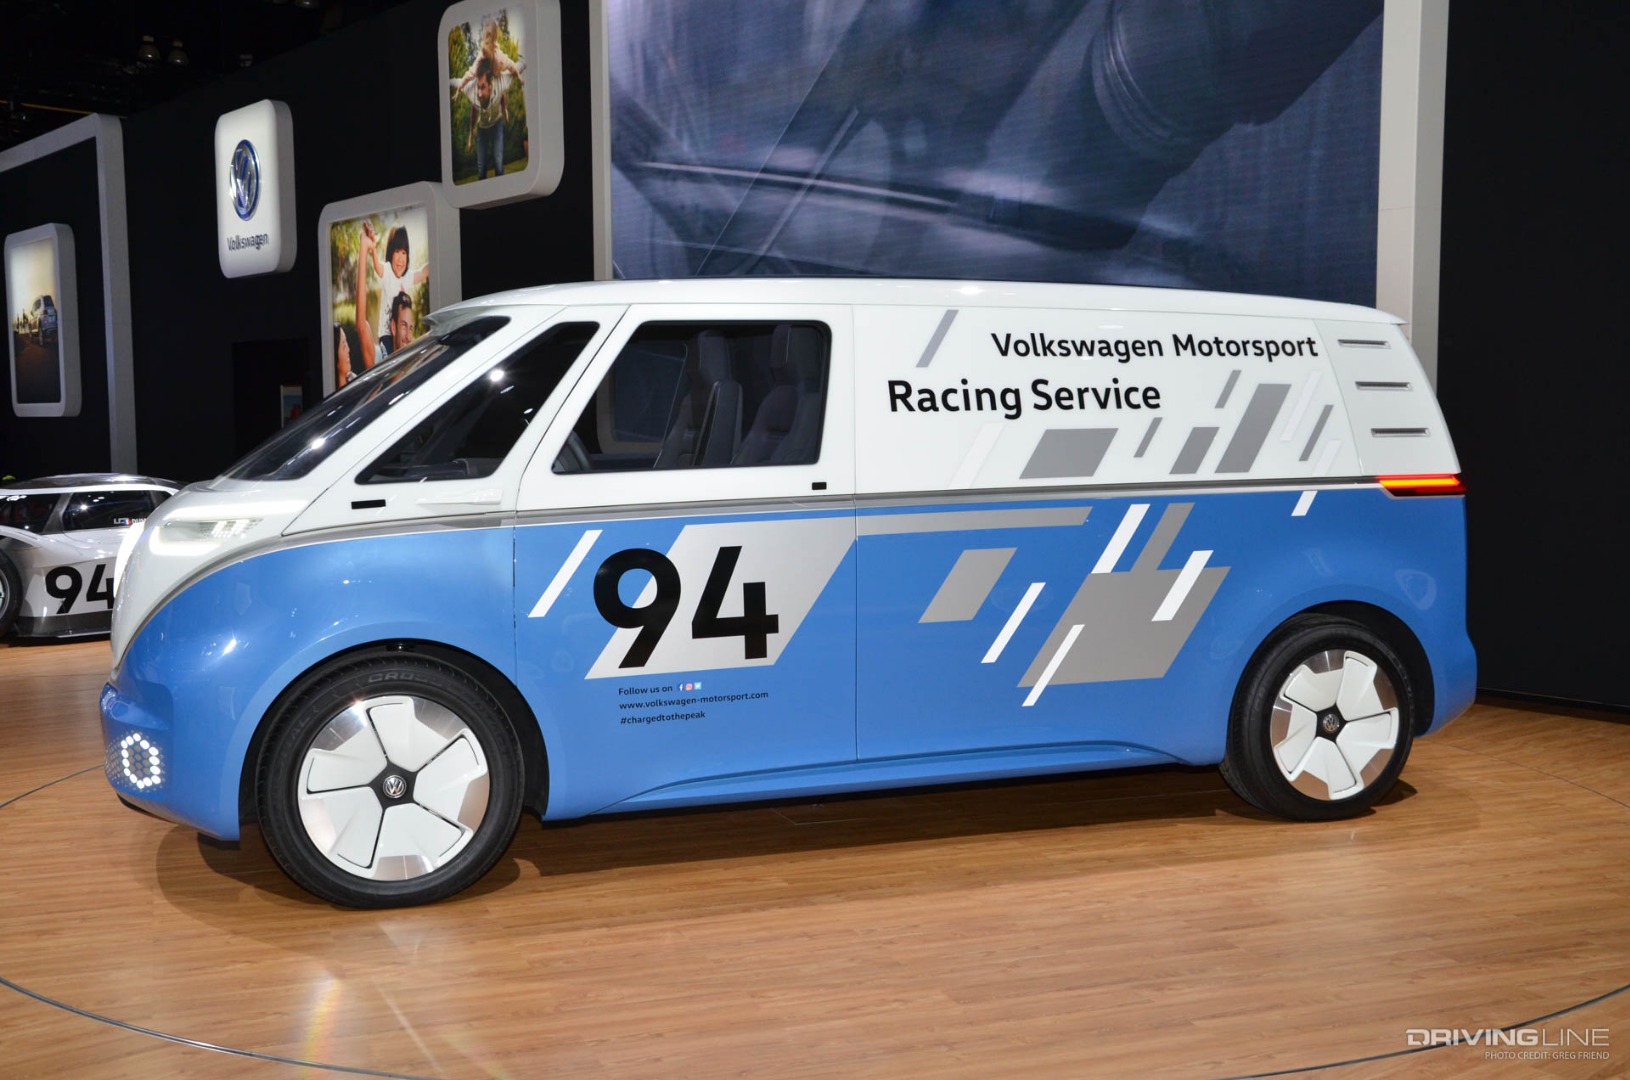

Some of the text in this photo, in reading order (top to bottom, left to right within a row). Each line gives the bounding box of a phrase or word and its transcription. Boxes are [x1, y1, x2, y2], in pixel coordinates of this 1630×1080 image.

[227, 233, 269, 251] Volkswagen
[991, 333, 1319, 363] Volkswagen Motorsport
[888, 378, 1161, 420] Racing Service
[45, 563, 114, 614] 94
[593, 545, 779, 669] 94
[618, 686, 648, 696] Follow
[662, 685, 673, 693] on
[619, 691, 769, 710] www.volkswagen-motorsport.com
[620, 710, 706, 725] #chargedtothepeak
